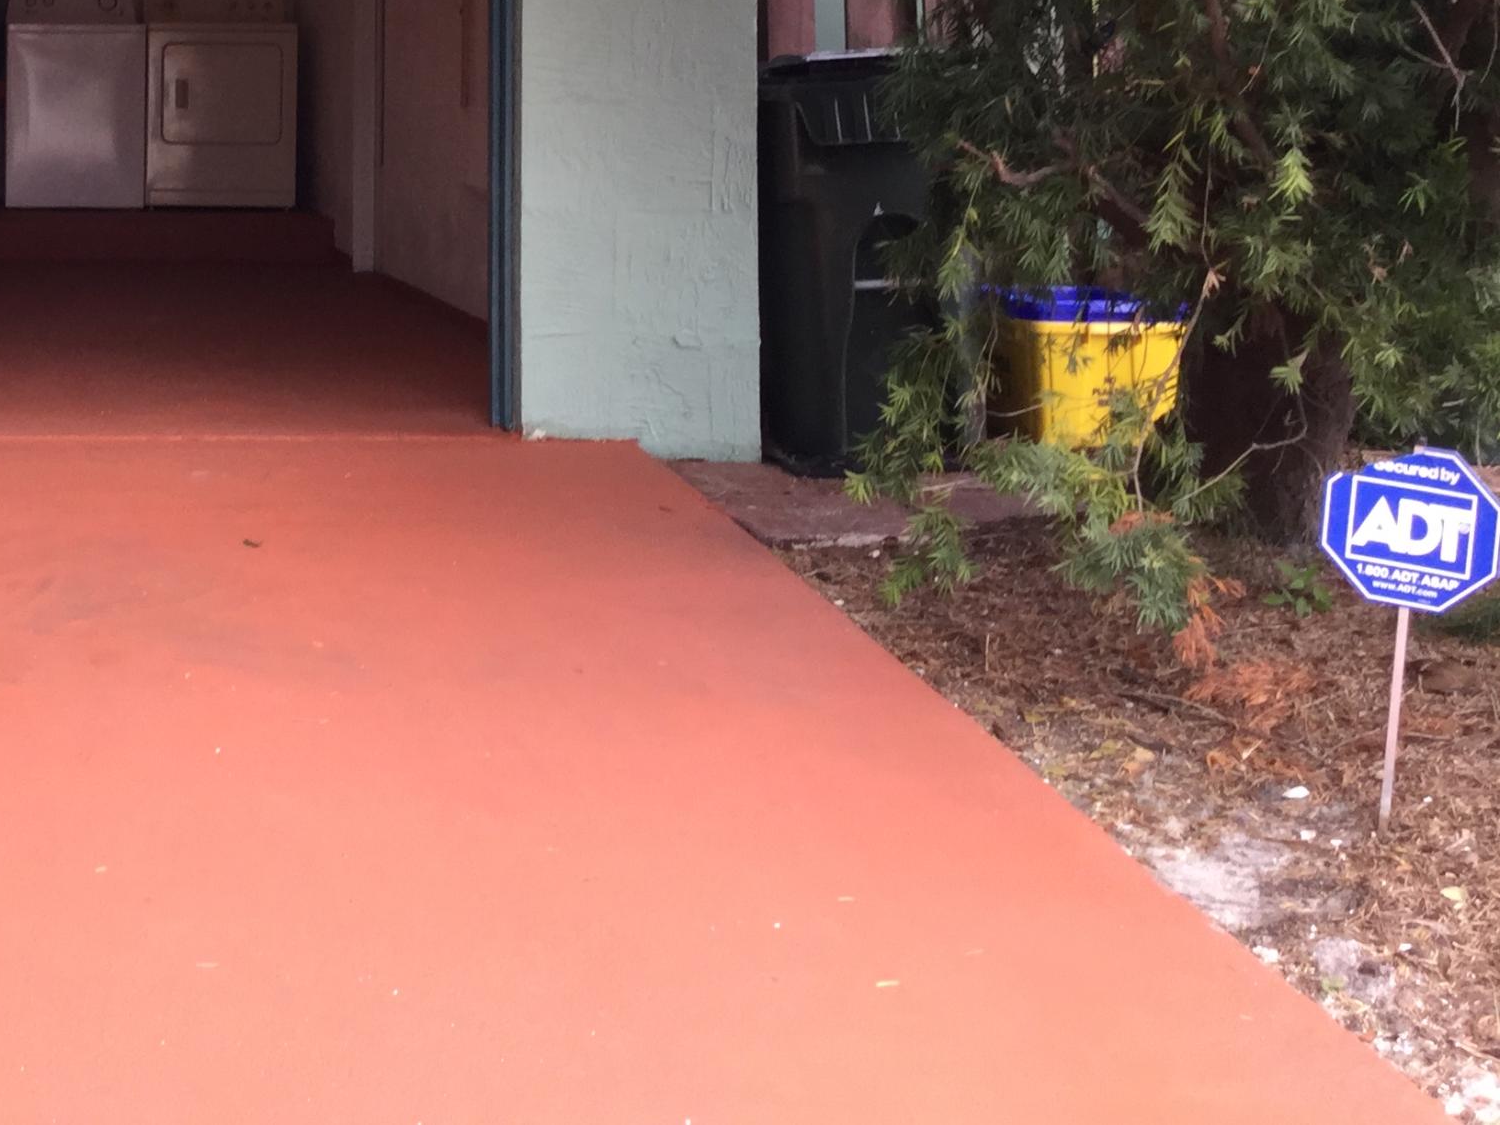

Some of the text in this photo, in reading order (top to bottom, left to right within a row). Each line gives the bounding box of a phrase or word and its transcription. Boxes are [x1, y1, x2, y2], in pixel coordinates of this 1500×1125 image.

[1373, 461, 1460, 485] secured by
[1351, 495, 1473, 563] ADT
